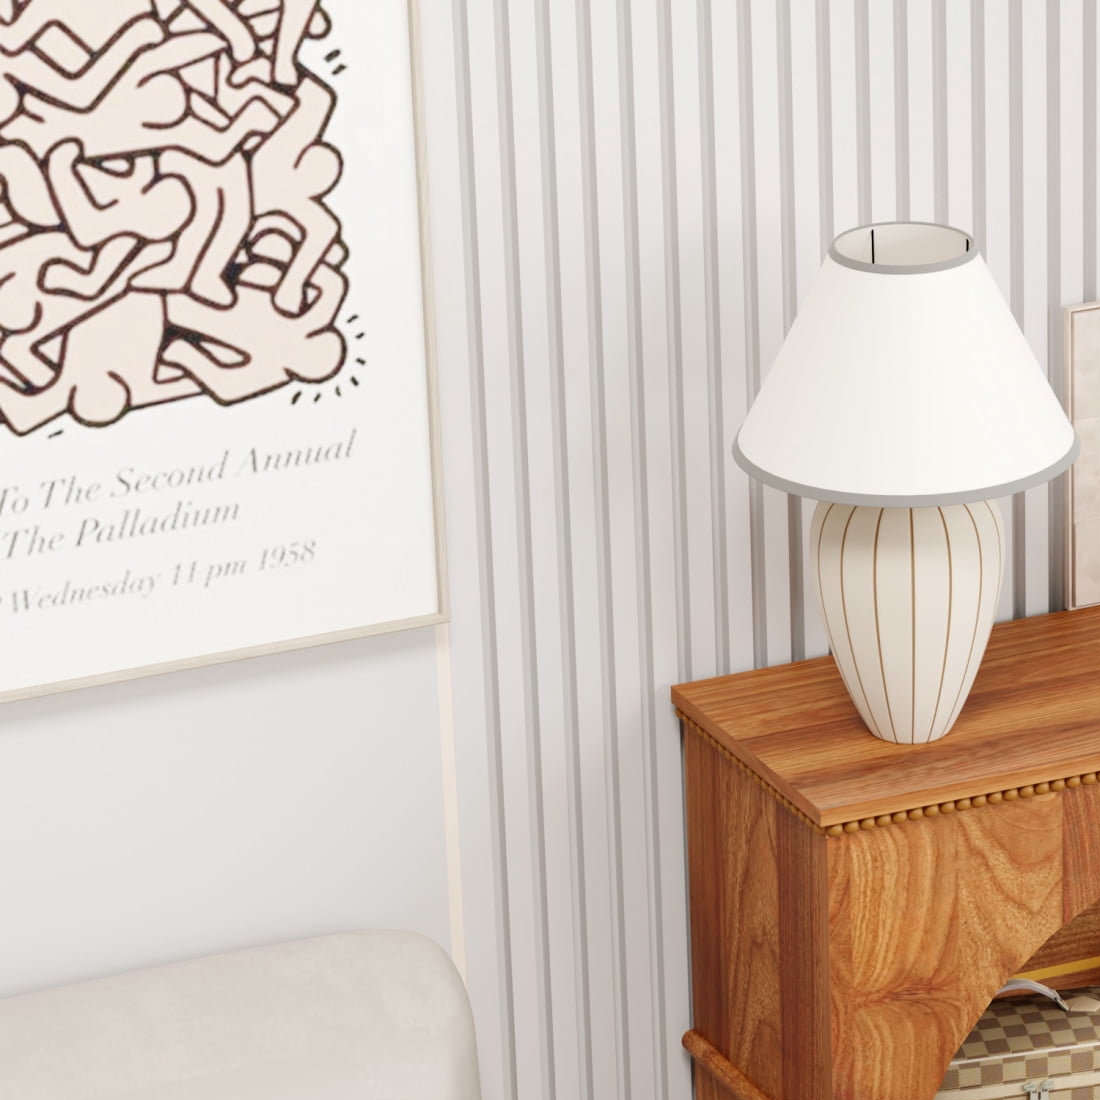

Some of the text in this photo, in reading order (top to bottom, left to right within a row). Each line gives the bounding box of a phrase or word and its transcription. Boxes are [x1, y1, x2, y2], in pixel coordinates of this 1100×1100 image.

[0, 428, 357, 516] To The Second Annual
[2, 500, 239, 559] The Palladium
[12, 569, 160, 614] Wednesday
[204, 560, 248, 588] pm
[259, 539, 316, 571] 1958
